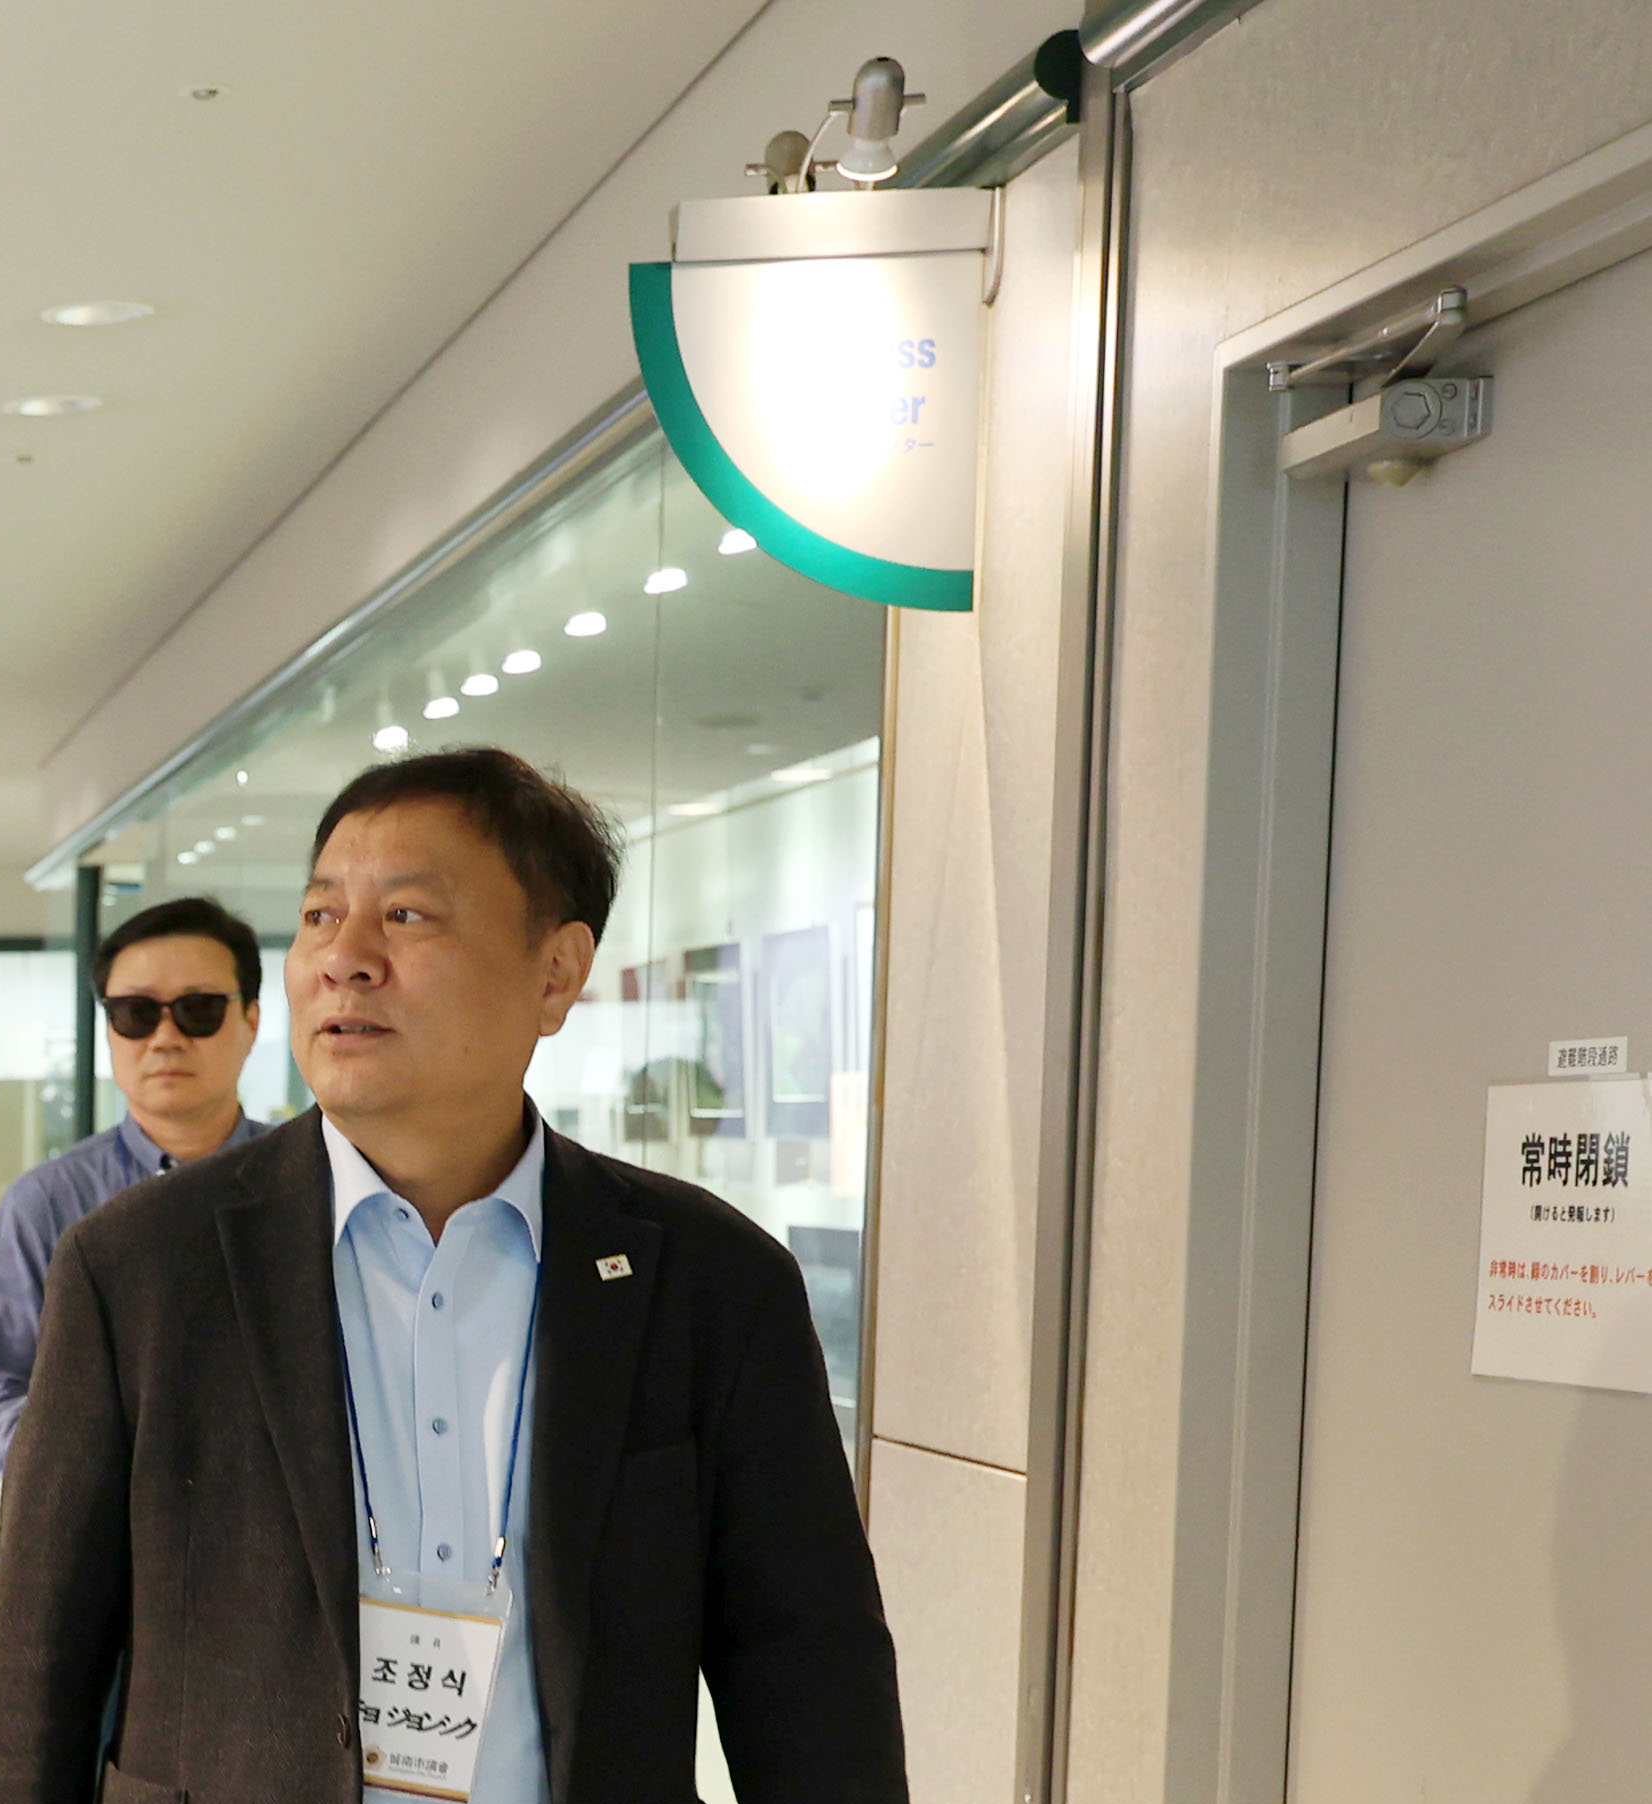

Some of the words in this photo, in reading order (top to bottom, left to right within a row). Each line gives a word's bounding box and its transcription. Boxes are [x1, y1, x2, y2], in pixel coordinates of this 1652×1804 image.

[1521, 1131, 1630, 1188] 常時閉鎖
[372, 1656, 467, 1697] 조정식
